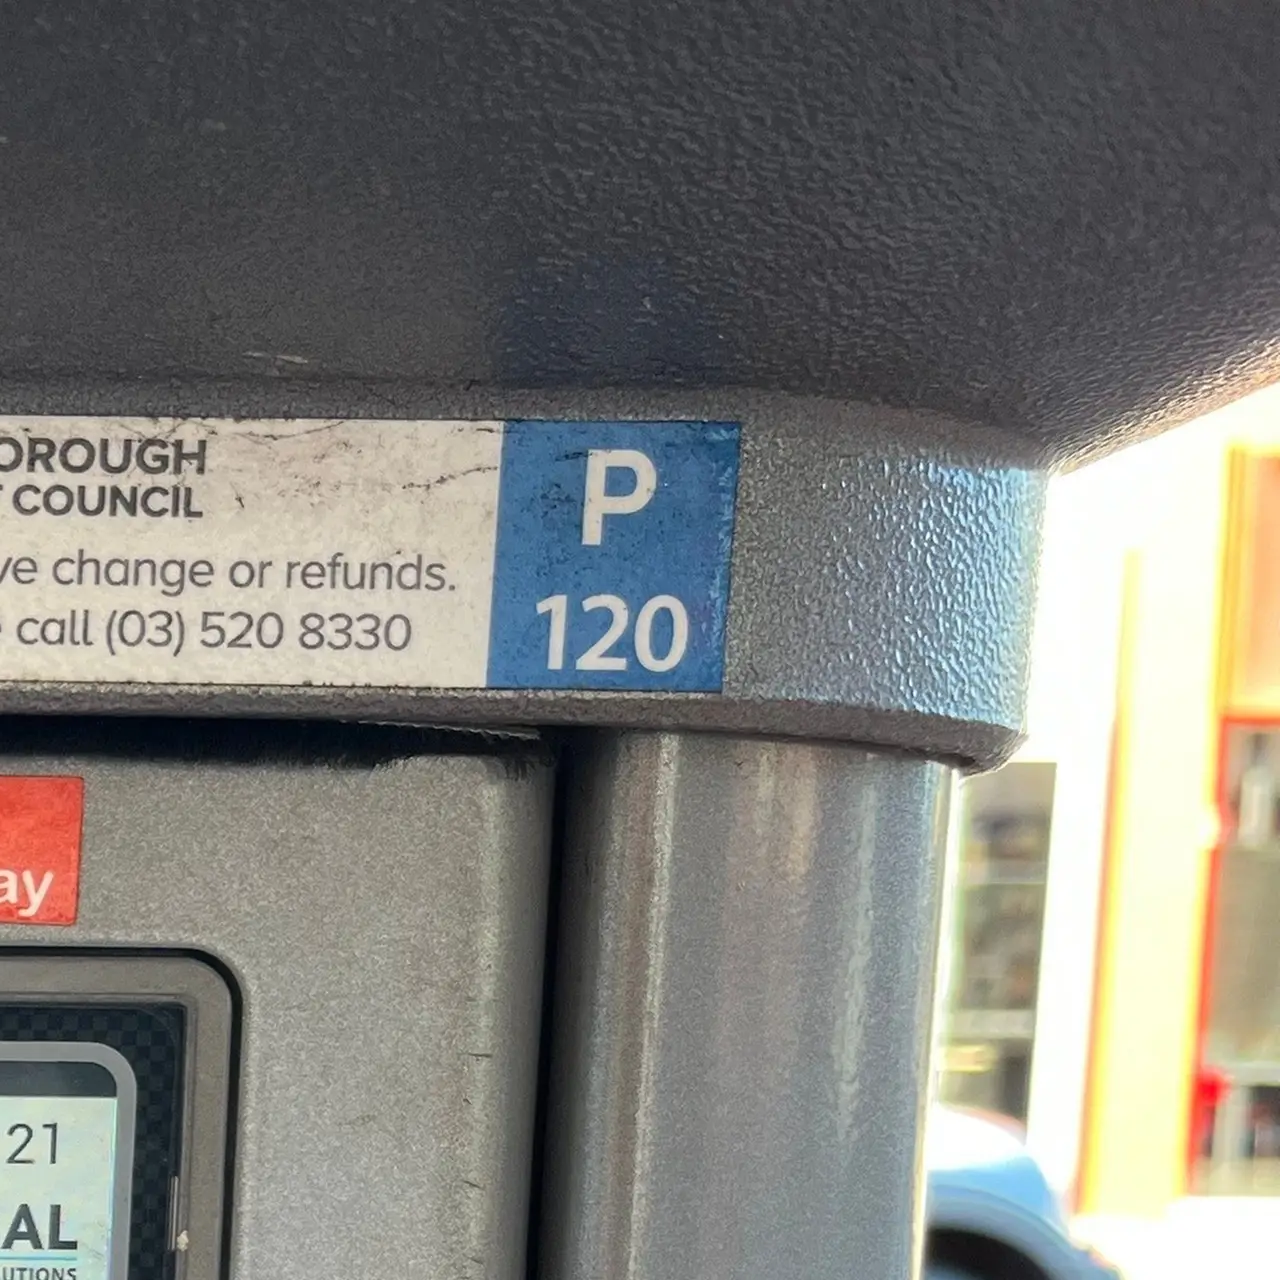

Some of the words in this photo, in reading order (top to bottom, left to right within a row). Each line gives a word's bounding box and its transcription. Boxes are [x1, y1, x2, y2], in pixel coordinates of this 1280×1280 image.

[12, 485, 203, 519] COUNCIL
[581, 449, 658, 546] P
[53, 550, 214, 596] change
[229, 558, 270, 588] or
[286, 553, 457, 592] refunds.
[16, 609, 90, 646] call
[106, 610, 184, 657] (03)
[200, 611, 283, 648] 520
[300, 613, 412, 651] 8330
[537, 593, 689, 673] 120
